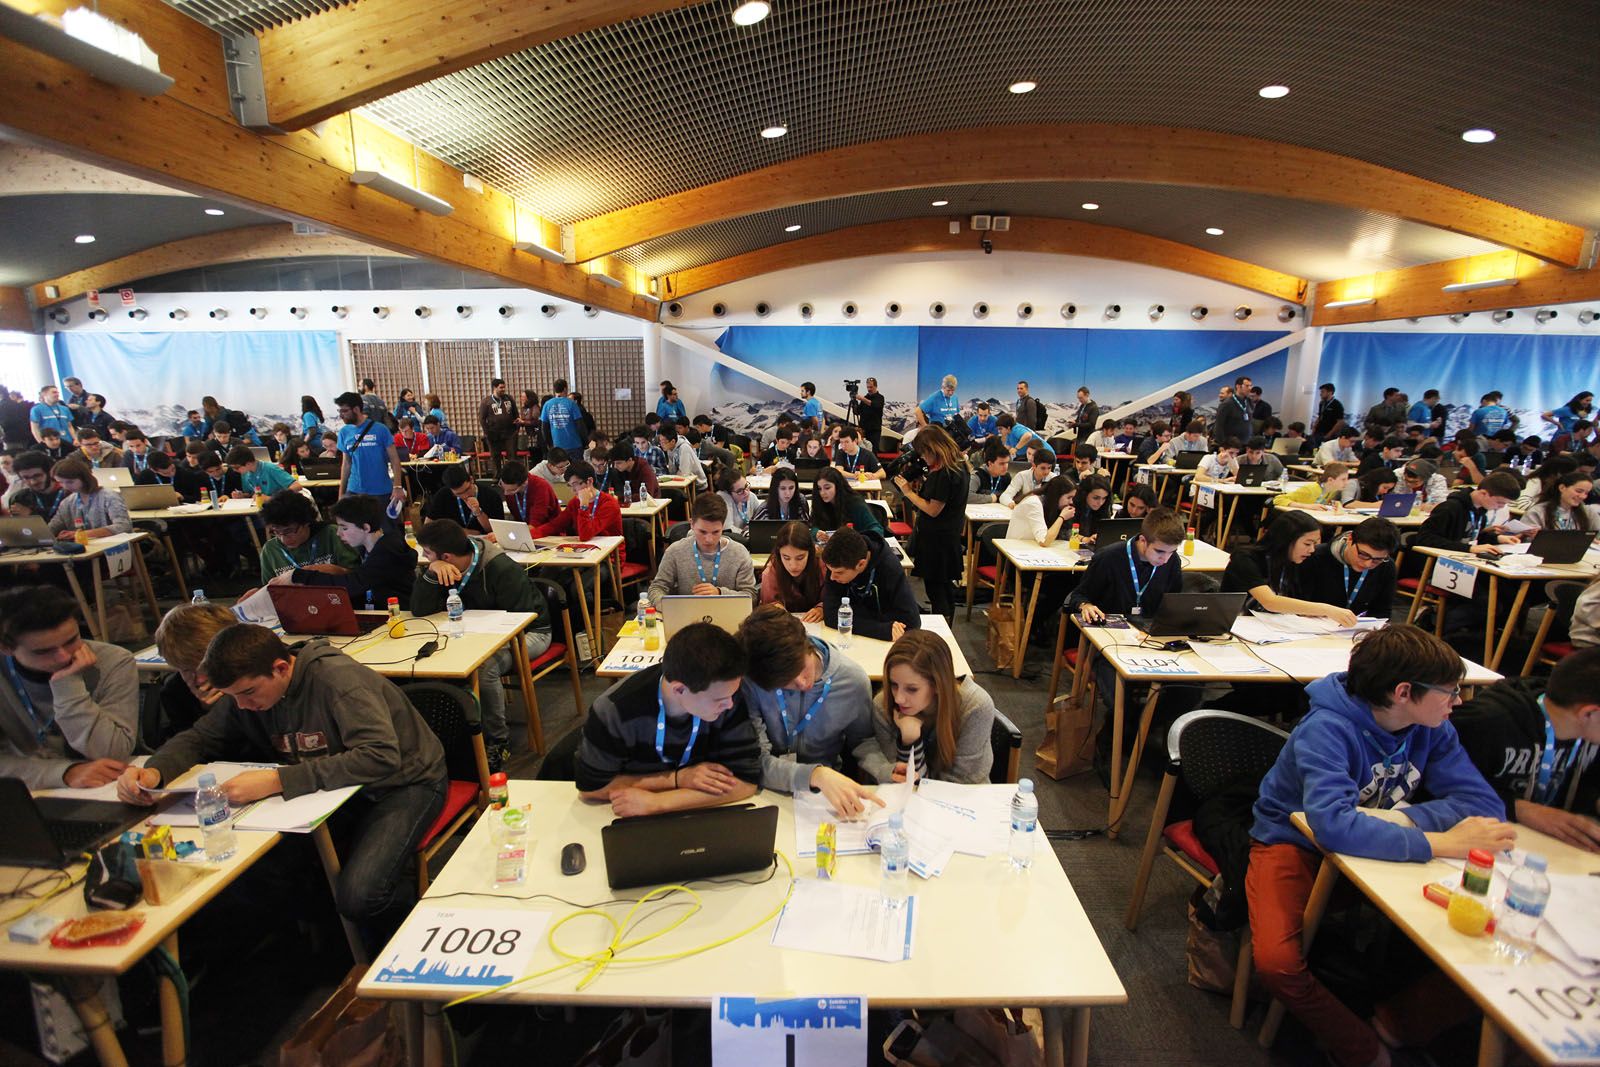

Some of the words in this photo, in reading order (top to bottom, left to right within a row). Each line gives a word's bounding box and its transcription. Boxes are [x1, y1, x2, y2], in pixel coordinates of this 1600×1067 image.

[1203, 494, 1209, 505] 5
[1446, 571, 1458, 590] 3
[420, 926, 521, 956] 1008
[1508, 985, 1600, 1020] 109
